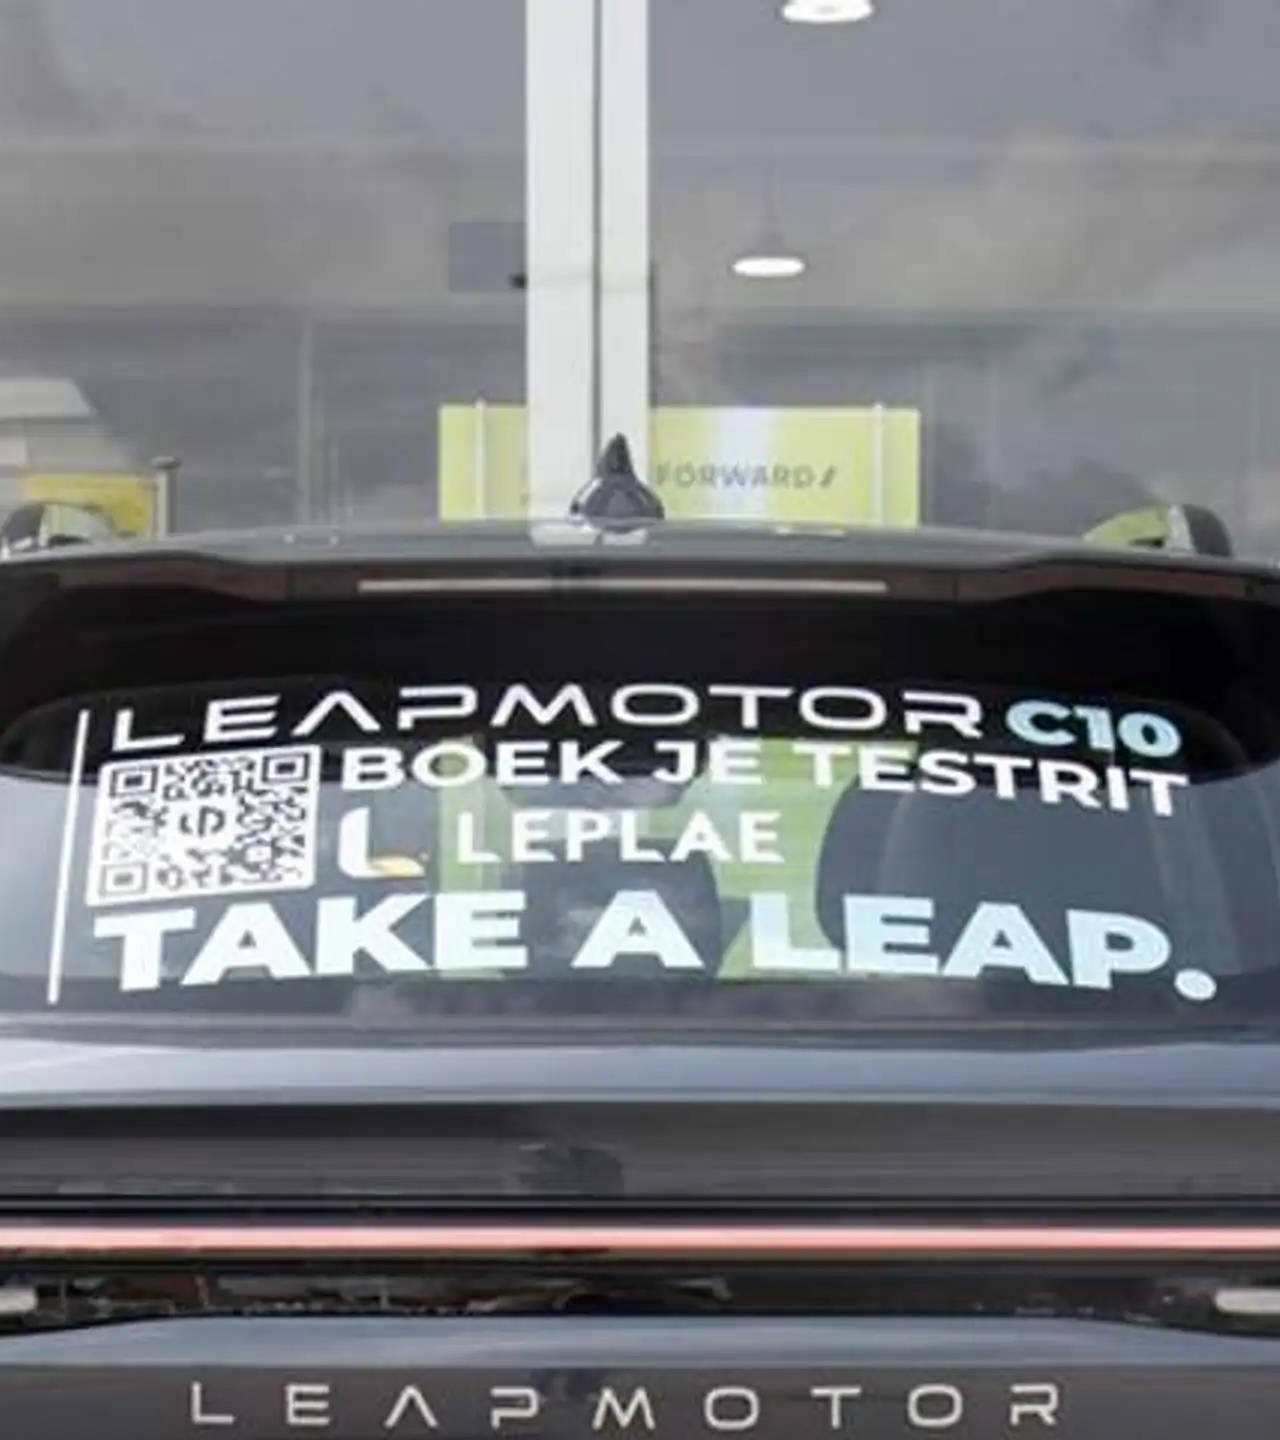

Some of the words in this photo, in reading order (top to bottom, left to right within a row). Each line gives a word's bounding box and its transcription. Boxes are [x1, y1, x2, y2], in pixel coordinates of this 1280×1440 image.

[112, 684, 982, 751] LEAPMOTOR
[1006, 700, 1181, 758] C10
[342, 739, 624, 791] BOEK
[654, 740, 762, 786] JE
[793, 741, 1188, 818] TESTRIT
[457, 809, 785, 864] LEPLAE
[94, 890, 528, 991] TAKE
[571, 890, 704, 968] A
[749, 892, 1217, 1002] LEAP.
[190, 1381, 1060, 1430] LEAPMOTOR
